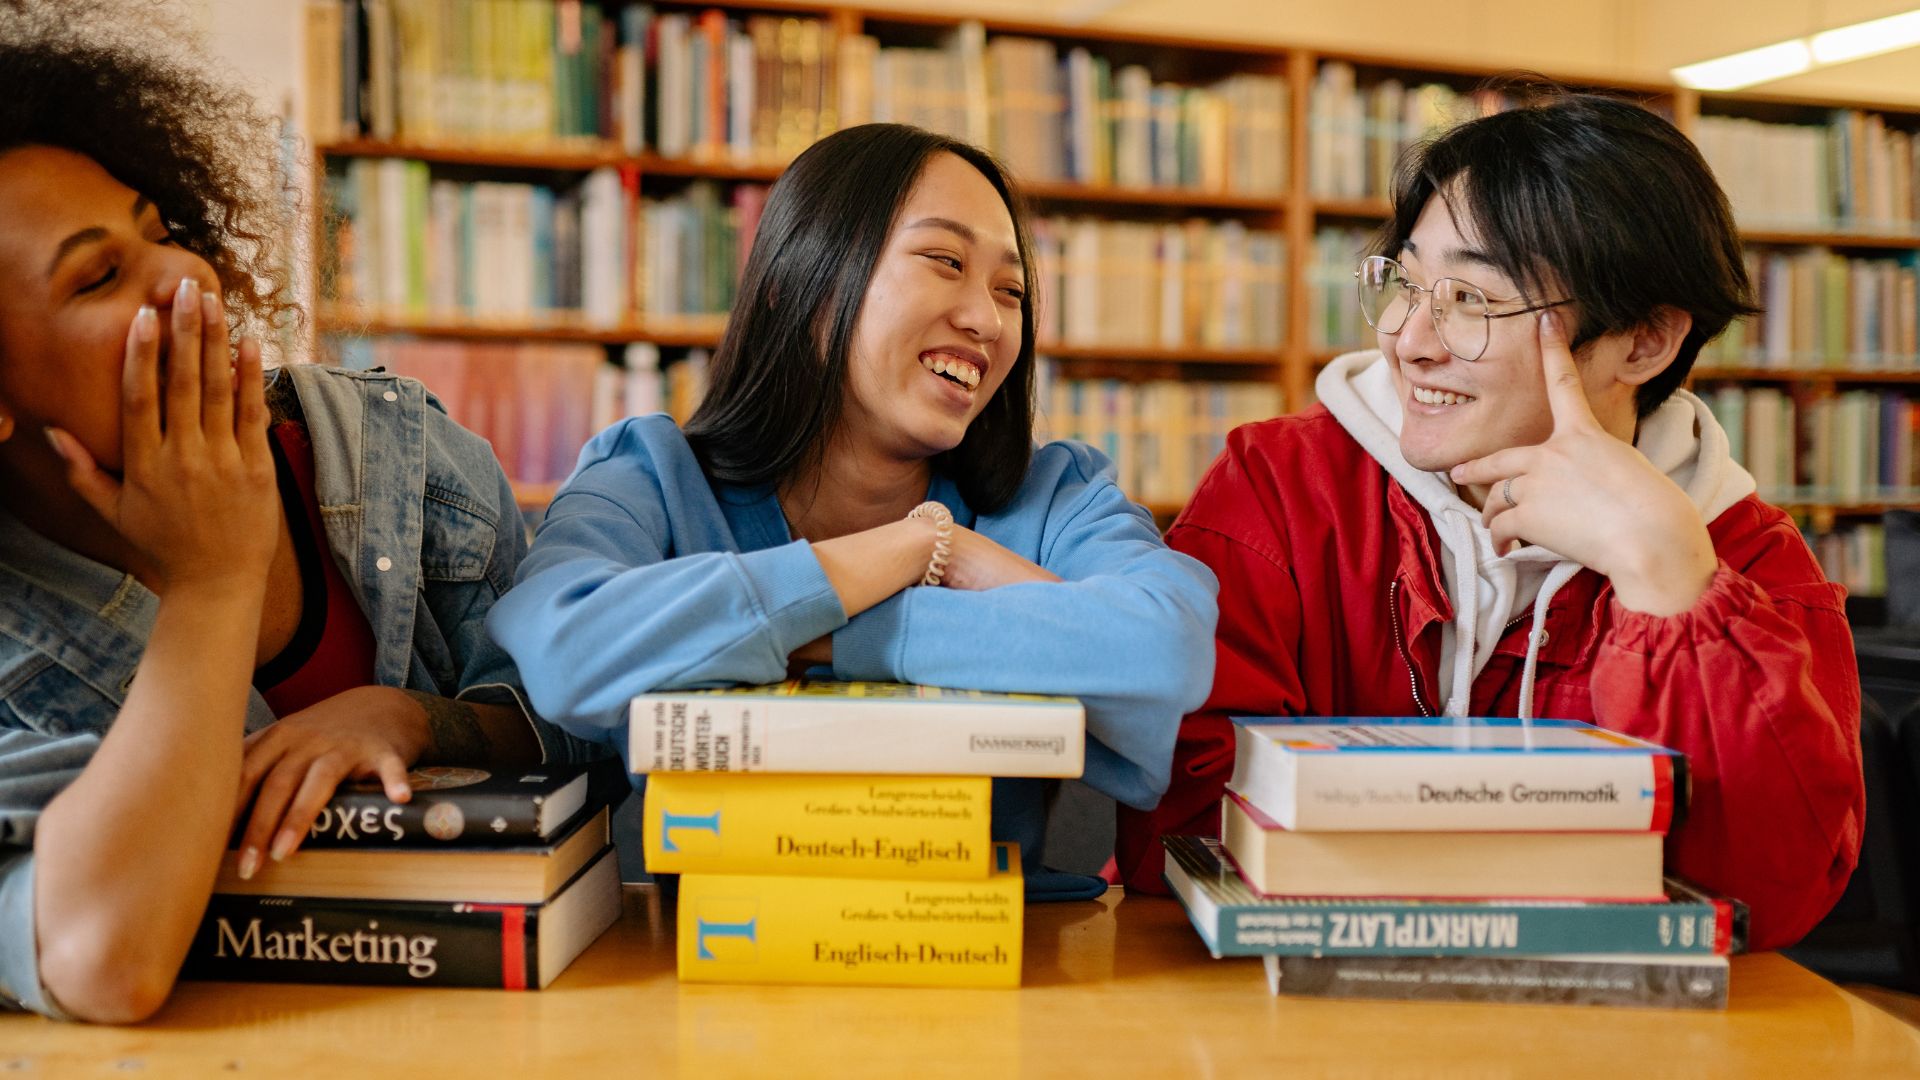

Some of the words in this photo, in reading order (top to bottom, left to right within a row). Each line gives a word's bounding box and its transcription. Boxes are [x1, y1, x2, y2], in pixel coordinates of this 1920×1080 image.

[670, 703, 687, 771] DEUTSCHE
[714, 735, 730, 771] BUCH
[868, 786, 973, 802] Langenscheidts
[1418, 782, 1504, 804] Deutsche
[1511, 782, 1620, 804] Grammatik
[804, 803, 852, 816] Großes
[856, 804, 973, 820] Schulwörterbuch
[776, 834, 971, 864] Deutsch-Englisch
[905, 891, 1010, 907] Langenscheidts
[841, 908, 889, 922] Großes
[893, 909, 1010, 923] Schulwörterbuch
[1327, 912, 1519, 948] MARKTPLATZ
[214, 916, 438, 979] Marketing
[814, 940, 1008, 969] Englisch-Deutsch
